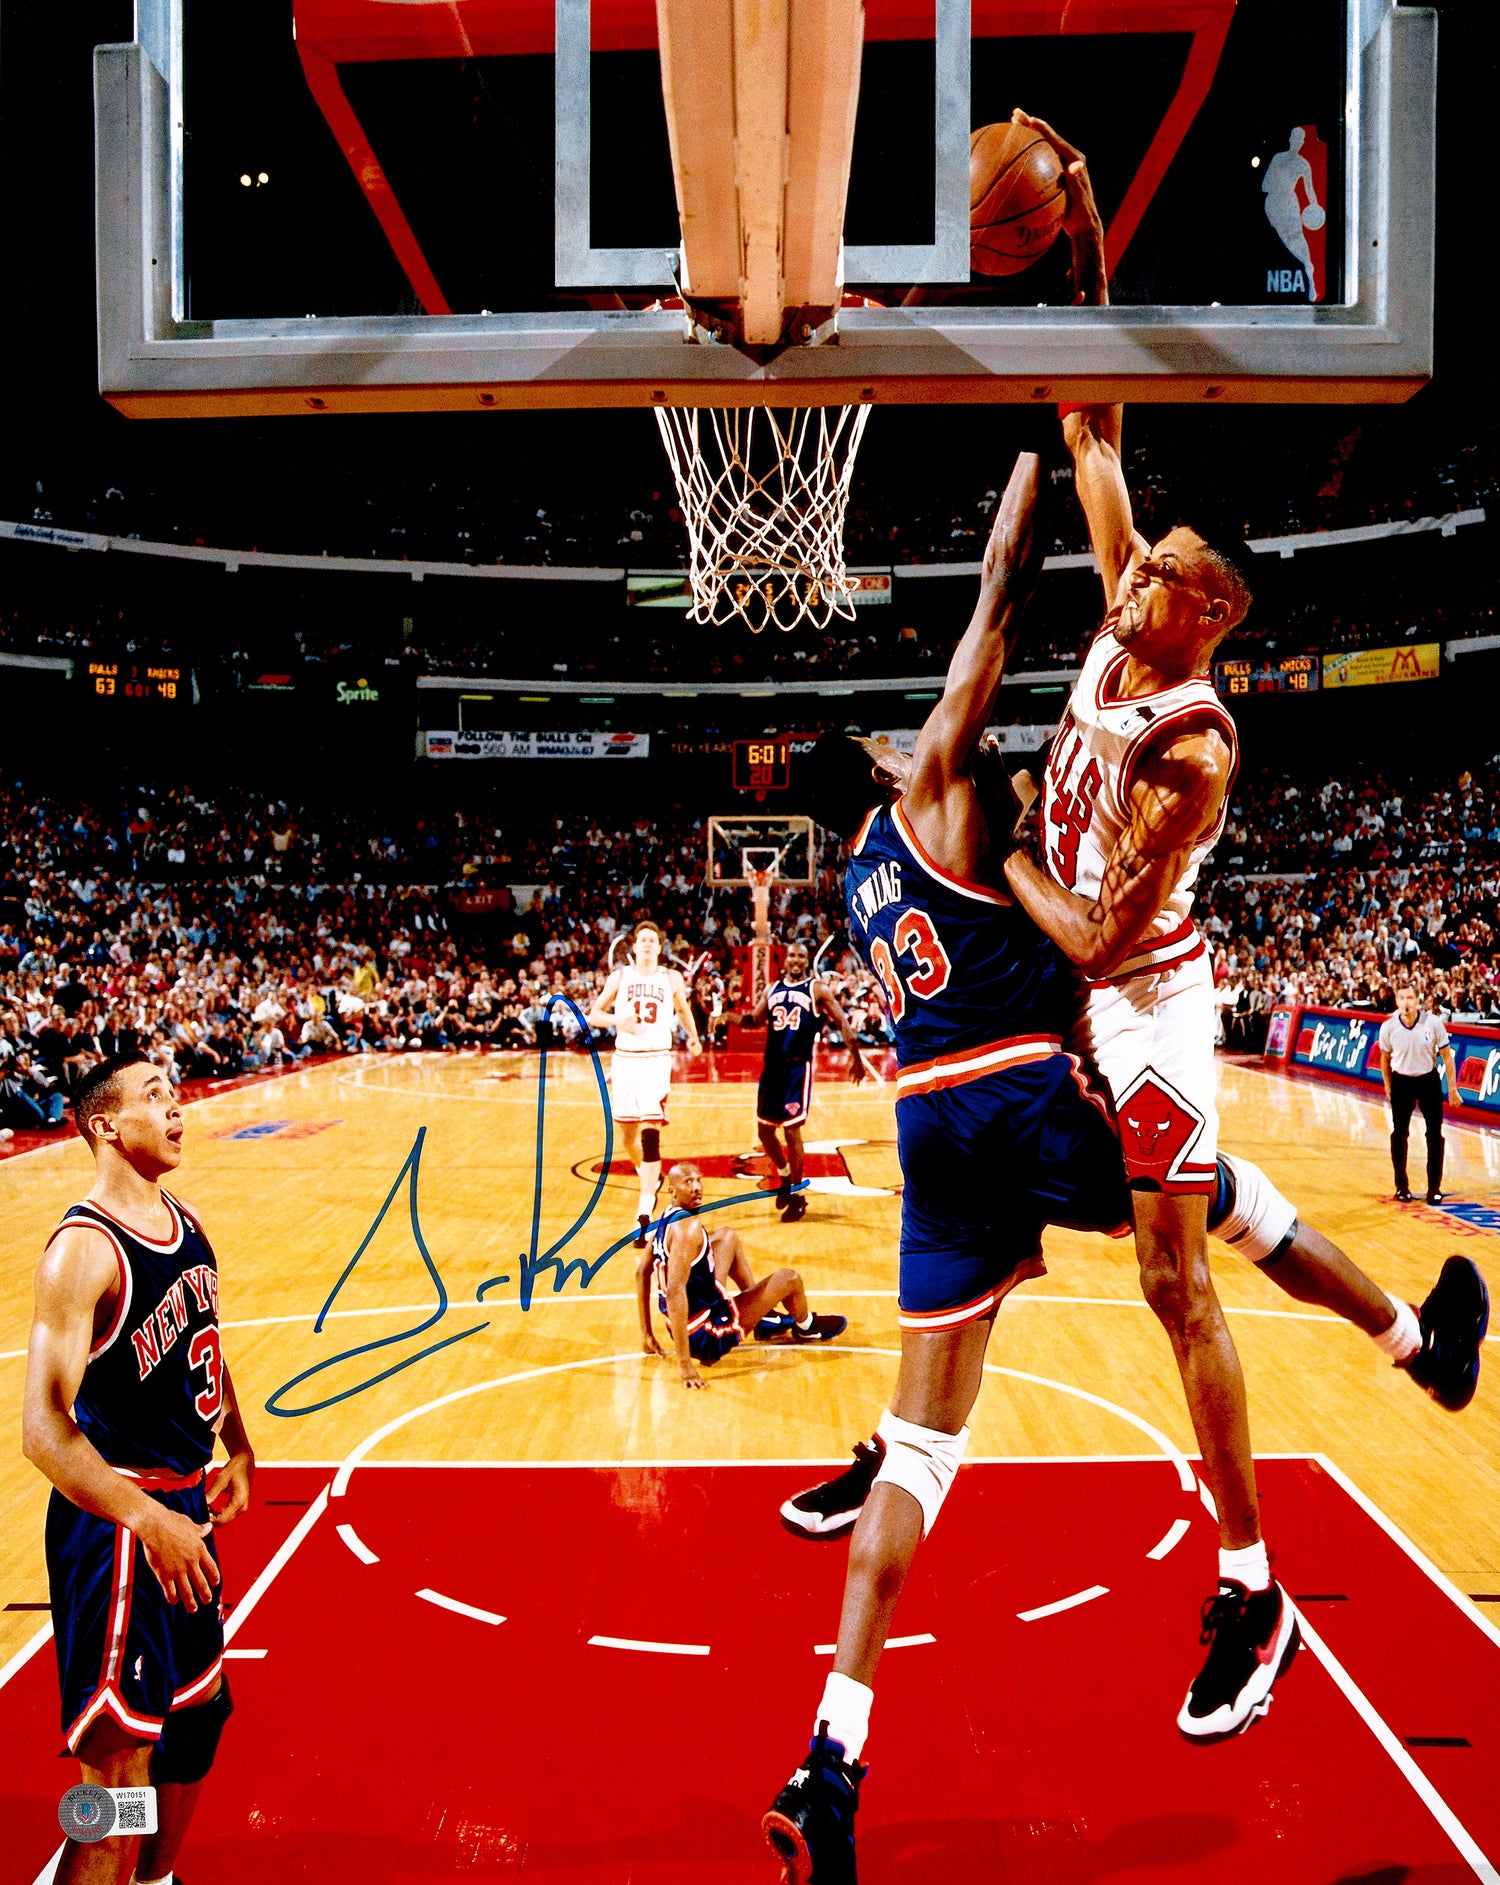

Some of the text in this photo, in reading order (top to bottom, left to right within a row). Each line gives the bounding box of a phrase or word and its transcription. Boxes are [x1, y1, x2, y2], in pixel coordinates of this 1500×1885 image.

[1266, 269, 1306, 293] NBA
[89, 662, 118, 675] BULLS
[1224, 662, 1251, 676] BULLS
[95, 677, 116, 695] 63
[157, 682, 177, 699] 48
[336, 679, 379, 705] Sprite
[1230, 676, 1249, 694] 63
[1289, 673, 1308, 690] 48
[458, 731, 592, 742] FOLLOW THE BULLS ON
[512, 744, 530, 754] AM
[748, 744, 786, 765] 6:01
[750, 765, 773, 785] 20
[852, 861, 902, 934] EWING
[870, 906, 952, 1026] 33
[627, 983, 664, 1003] BULLS
[634, 1001, 658, 1024] 13
[772, 1005, 802, 1031] 34
[131, 1276, 189, 1382] NEW
[188, 1324, 225, 1421] 3
